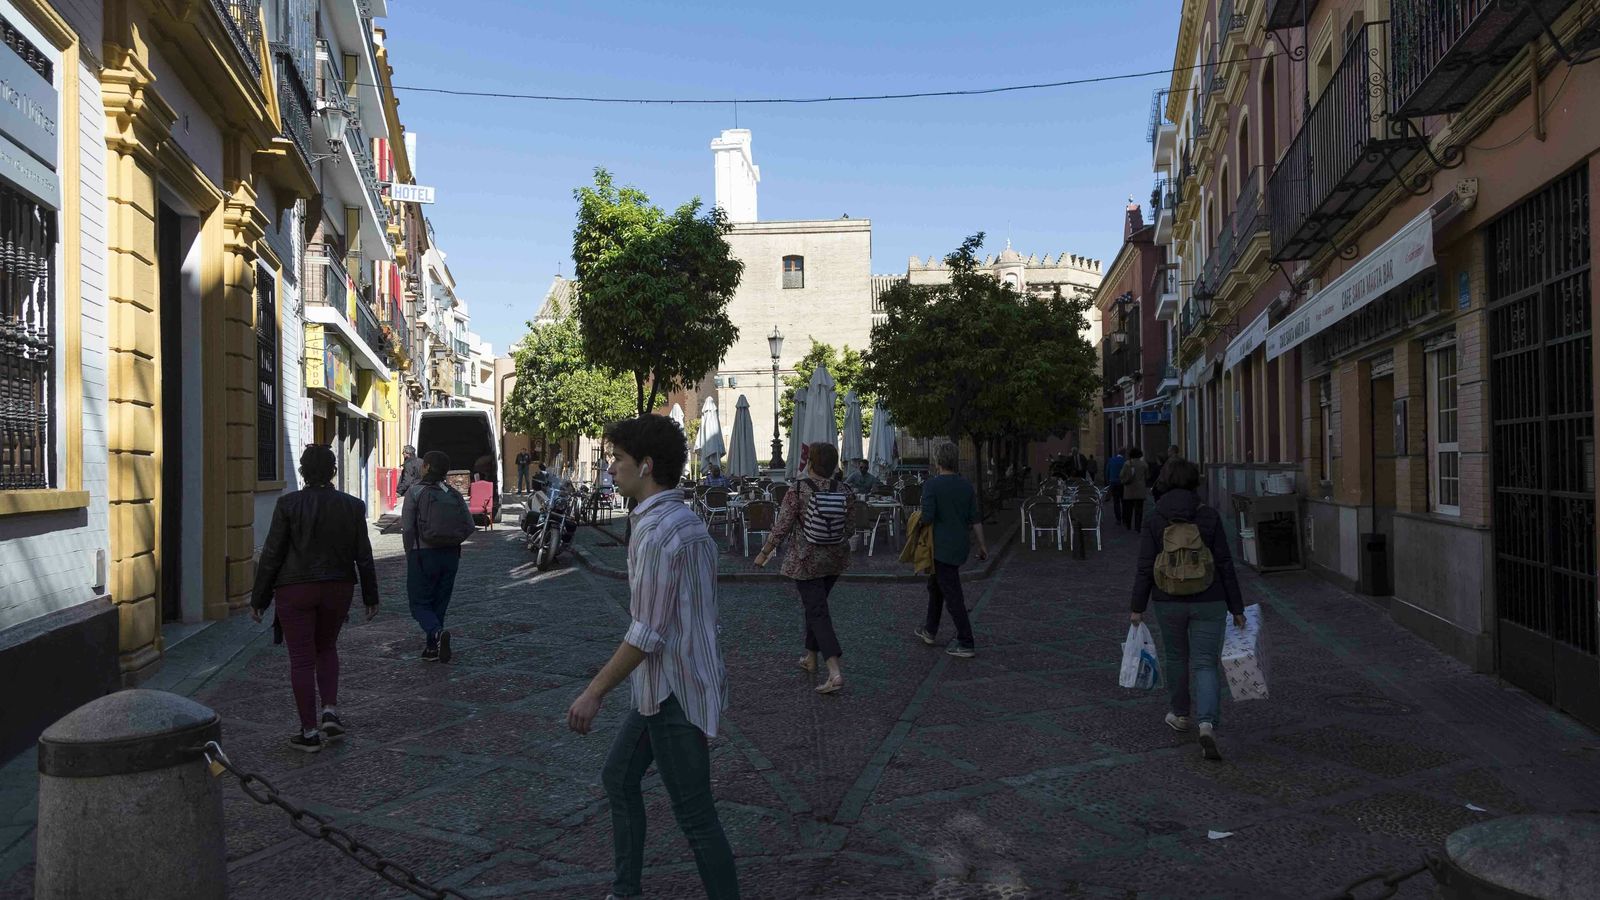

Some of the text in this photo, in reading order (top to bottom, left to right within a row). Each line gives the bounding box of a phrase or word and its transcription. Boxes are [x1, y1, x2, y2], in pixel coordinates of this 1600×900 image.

[394, 185, 431, 201] HOTEL
[1352, 279, 1365, 304] SANTA
[1366, 268, 1383, 295] MARTA
[1383, 258, 1394, 284] BAR
